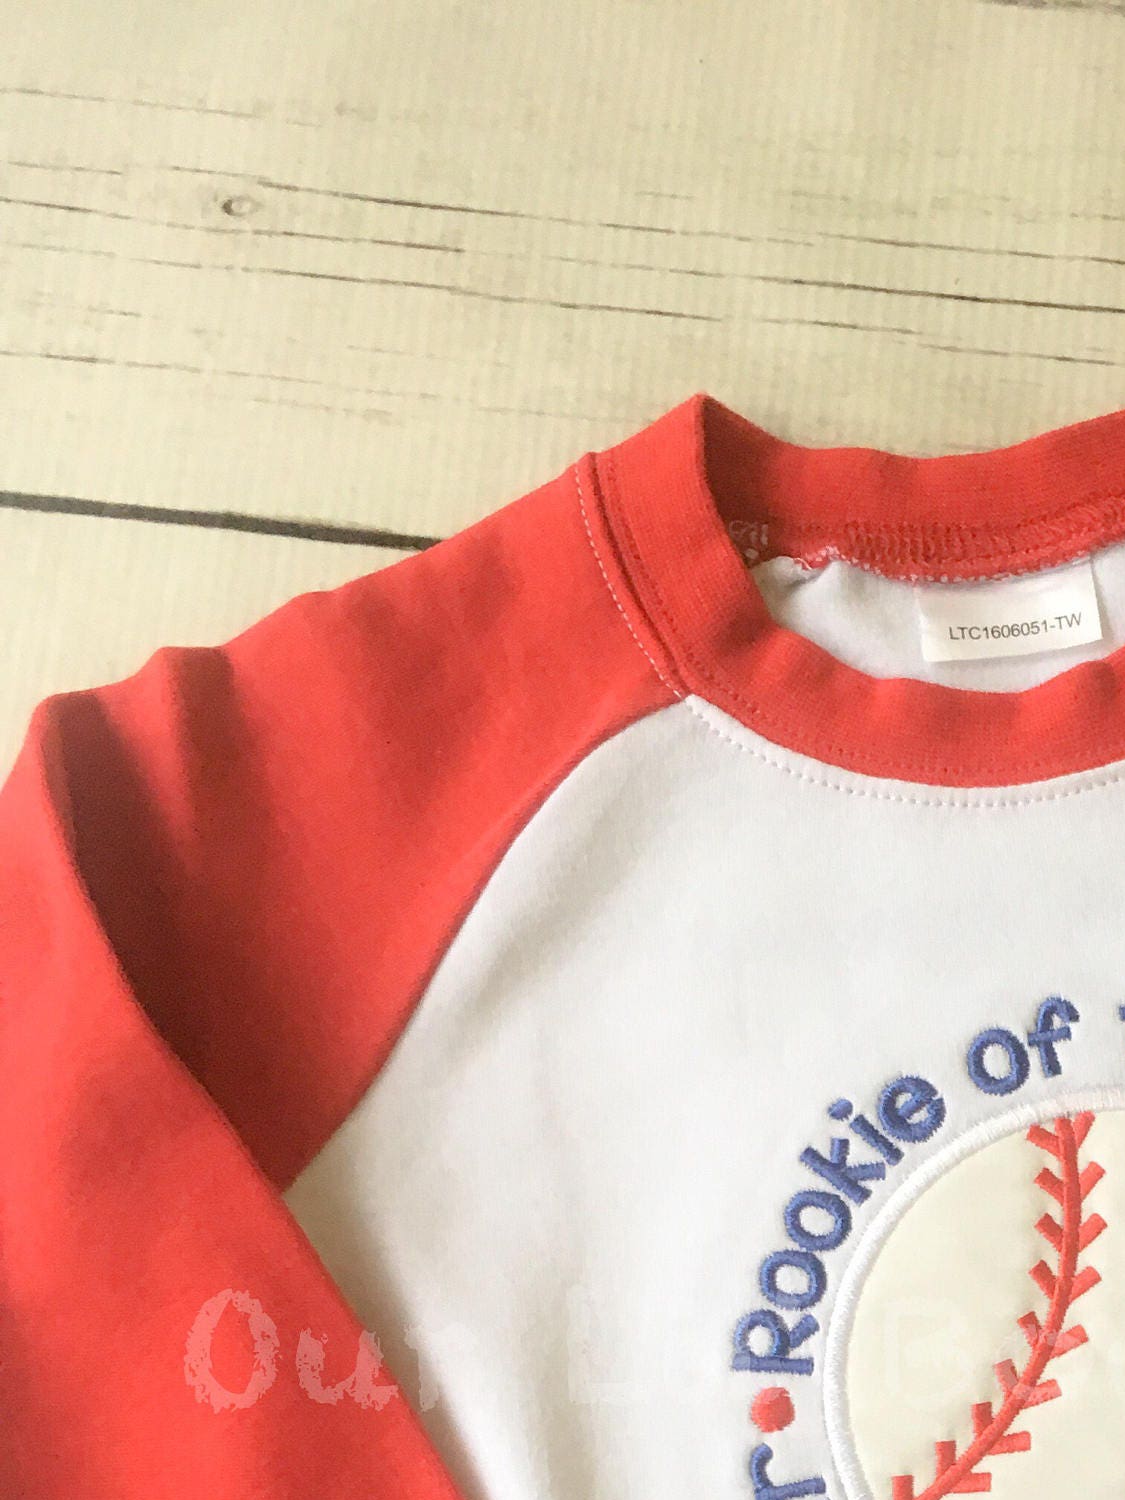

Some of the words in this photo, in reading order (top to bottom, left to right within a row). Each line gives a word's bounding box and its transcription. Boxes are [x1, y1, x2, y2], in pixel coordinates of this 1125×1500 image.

[948, 611, 1083, 641] LTC1606051-TW
[731, 1073, 945, 1376] Rookie
[966, 993, 1079, 1096] of
